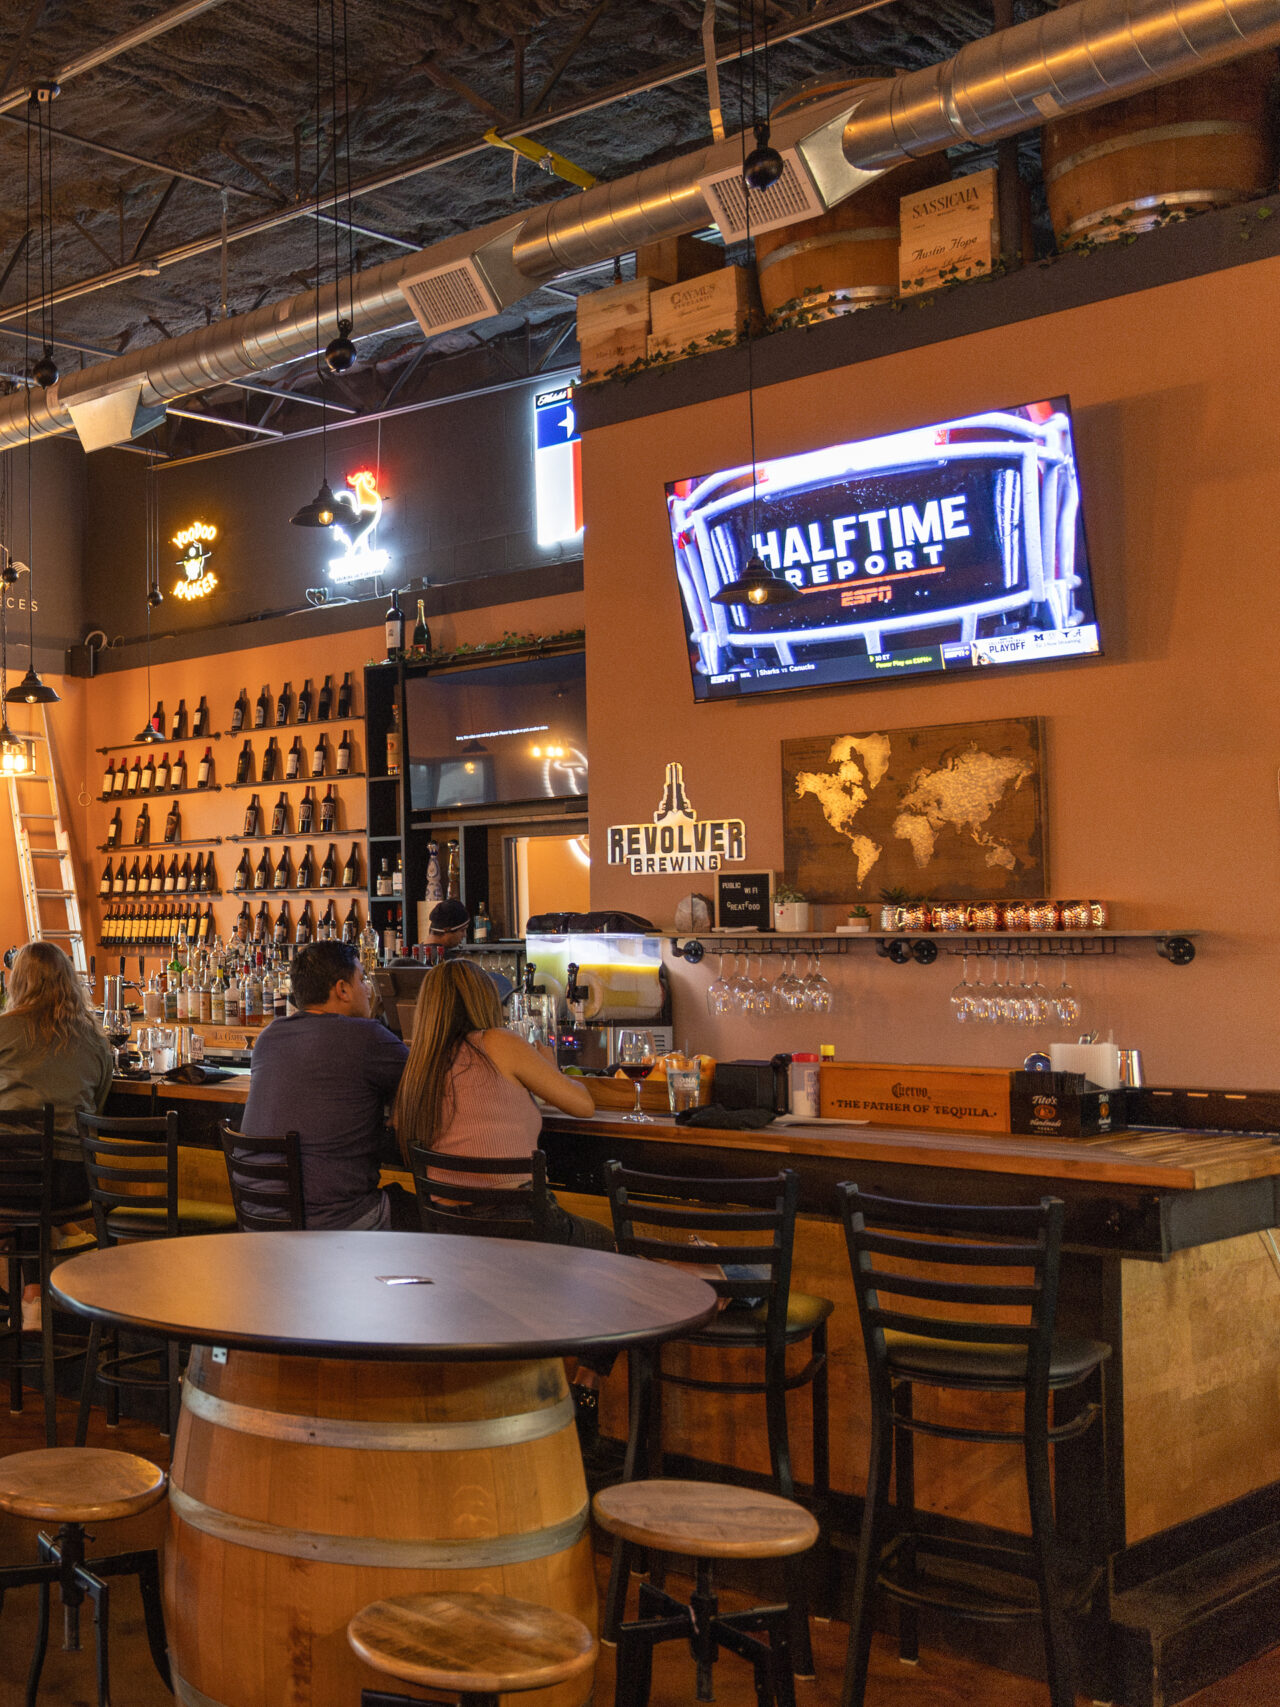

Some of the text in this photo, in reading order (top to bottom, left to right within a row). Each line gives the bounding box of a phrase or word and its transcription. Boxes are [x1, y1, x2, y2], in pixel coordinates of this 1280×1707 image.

[912, 236, 978, 262] Austin Hope
[172, 521, 217, 549] VOODOO
[751, 495, 971, 570] HALFTIME
[784, 544, 943, 587] REPORT
[173, 572, 218, 601] RANGER
[840, 585, 892, 607] ESPN
[988, 641, 1026, 653] PLAYOFF
[759, 668, 780, 676] Sharks
[789, 663, 816, 672] Canucks
[610, 821, 743, 864] REVOLVER
[633, 855, 719, 873] BREWING
[891, 1082, 928, 1099] Cuervo
[1031, 1095, 1058, 1105] Tito's
[837, 1100, 860, 1109] THE
[863, 1102, 910, 1113] FATHER
[912, 1103, 929, 1113] OF
